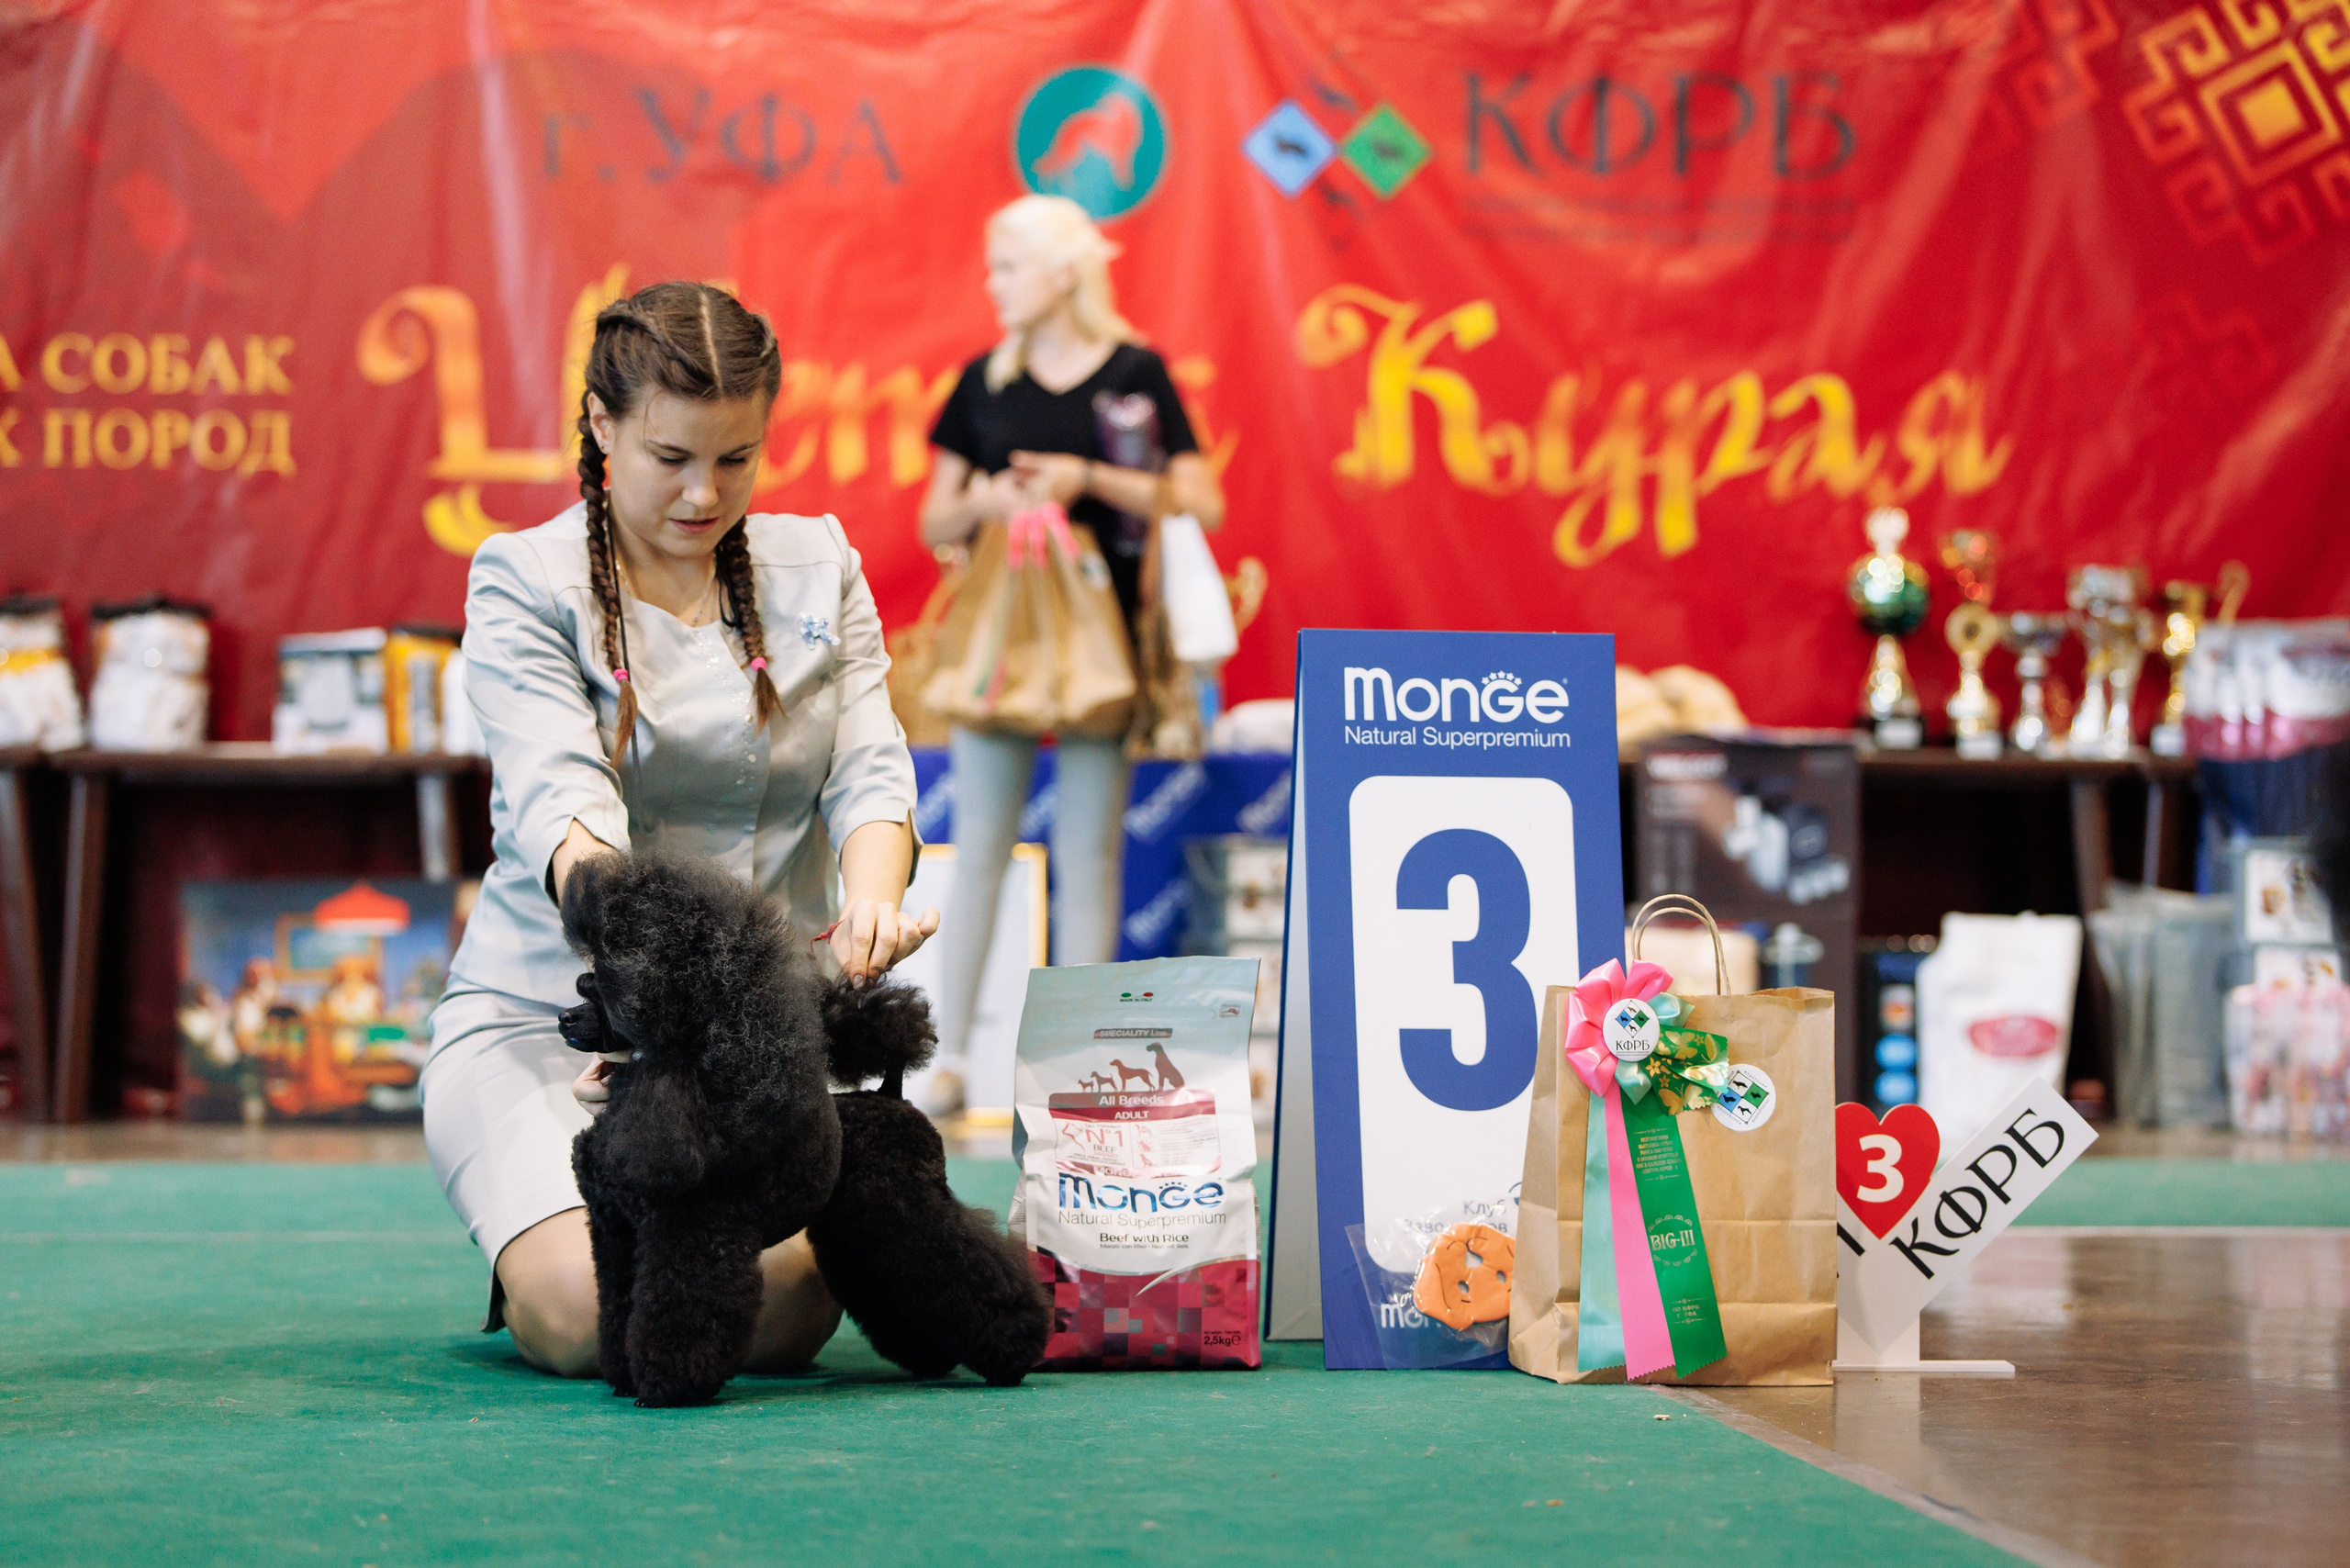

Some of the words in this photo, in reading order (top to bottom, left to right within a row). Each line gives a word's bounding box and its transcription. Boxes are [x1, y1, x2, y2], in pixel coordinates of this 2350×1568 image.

[1465, 70, 1858, 182] КФРБ
[42, 331, 296, 395] СОБАК
[46, 409, 297, 479] ПОРОД
[1345, 725, 1416, 745] Natural
[1423, 726, 1571, 750] Superpremium
[1396, 828, 1539, 1111] 3
[1099, 1029, 1149, 1037] SPECIALITY
[1616, 1039, 1651, 1051] КФРБ
[1099, 1095, 1116, 1105] All
[1118, 1094, 1165, 1106] Breeds
[1113, 1110, 1149, 1120] ADULT
[1856, 1133, 1905, 1204] 3
[1888, 1107, 2065, 1280] КФРБ
[1058, 1211, 1113, 1225] Natural
[1117, 1211, 1226, 1229] Superpremium
[1100, 1232, 1128, 1243] Beef
[1133, 1233, 1159, 1243] with
[1162, 1233, 1189, 1243] Rice
[1650, 1229, 1695, 1251] BIG-III
